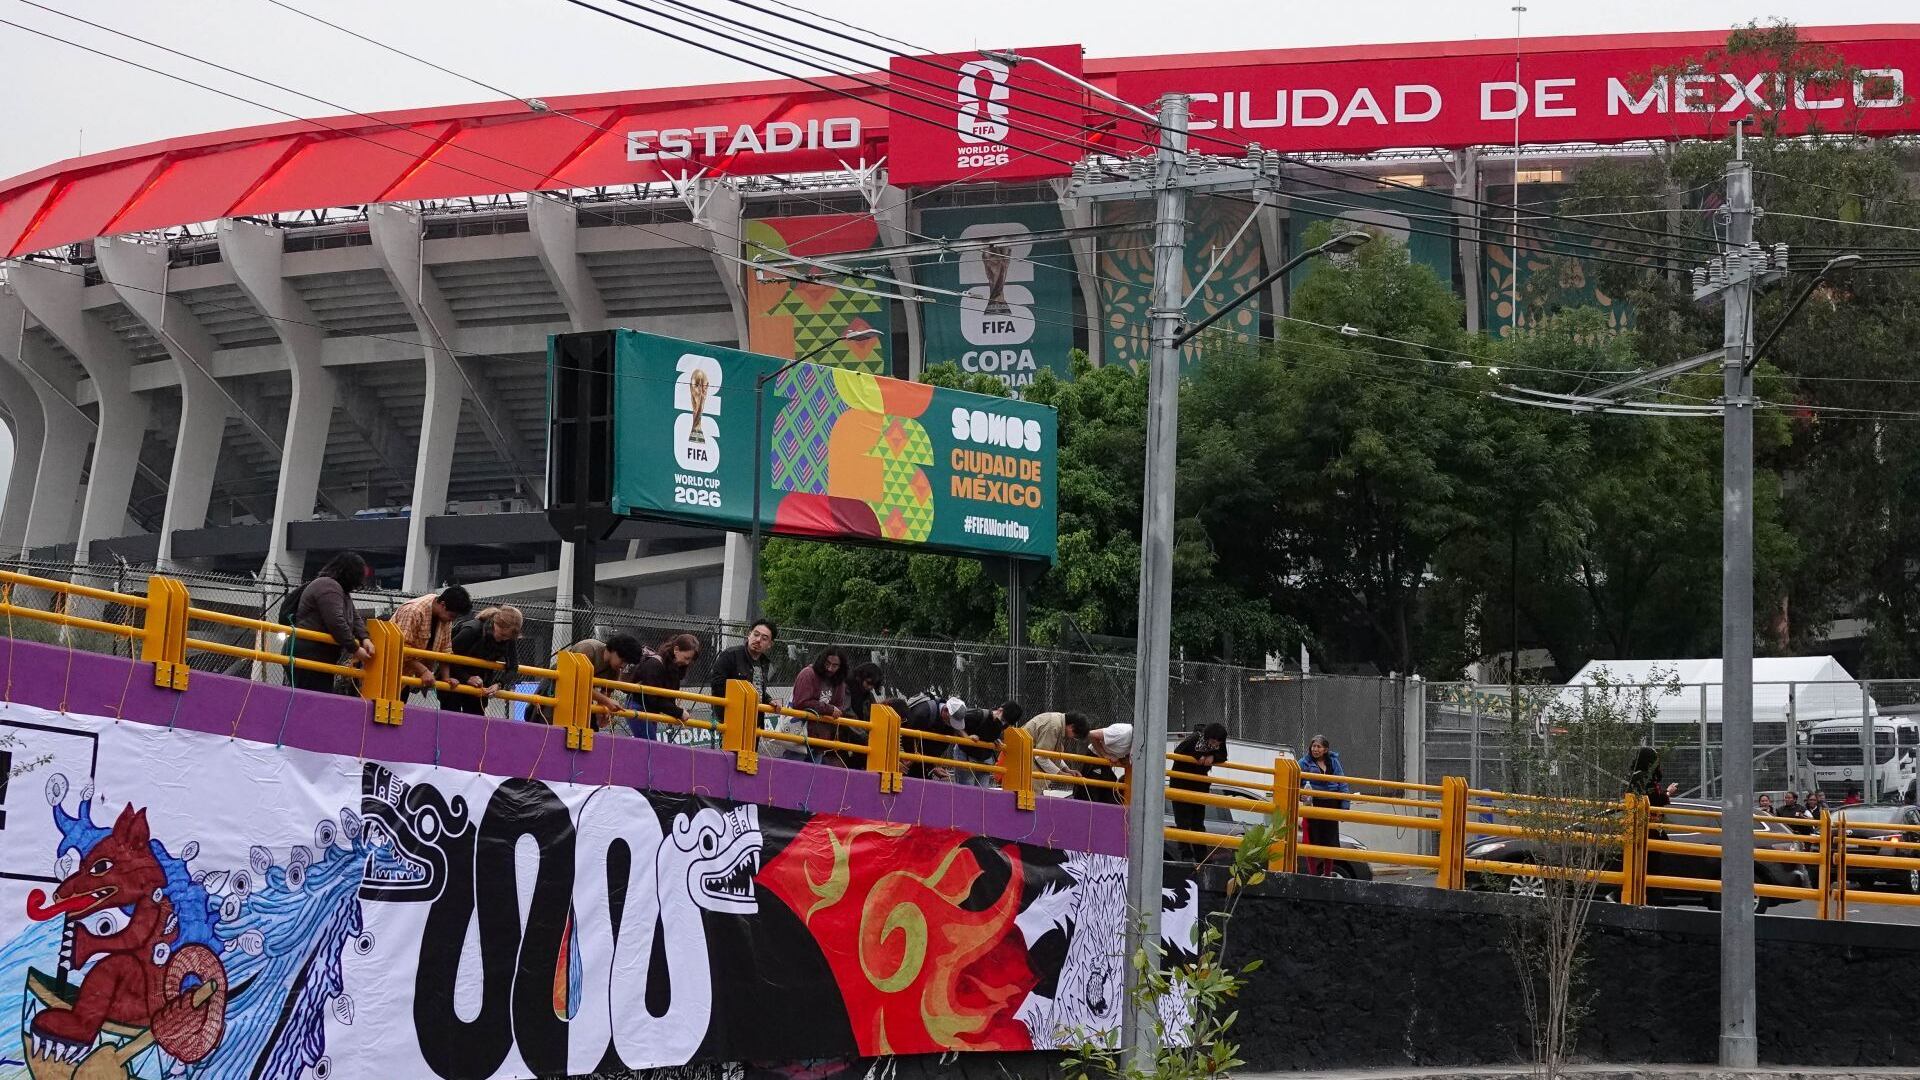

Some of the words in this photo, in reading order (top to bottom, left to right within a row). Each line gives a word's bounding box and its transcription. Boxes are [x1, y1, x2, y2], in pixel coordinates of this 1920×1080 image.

[1186, 84, 1442, 130] CIUDAD
[1480, 78, 1577, 121] DE
[627, 117, 861, 162] ESTADIO
[972, 125, 996, 135] FIFA
[957, 153, 1009, 169] 2026
[958, 145, 990, 155] WORLD
[990, 144, 1009, 153] CUP
[982, 320, 1016, 334] FIFA
[961, 349, 1037, 373] COPA
[951, 407, 1042, 452] SOMOS
[687, 447, 708, 462] FIFA
[951, 448, 1017, 478] CIUDAD
[1019, 458, 1041, 482] DE
[674, 473, 703, 487] WORLD
[704, 477, 721, 488] CUP
[951, 473, 1041, 509] MÉXICO
[674, 486, 722, 508] 2026
[964, 515, 1030, 543] #FIFAWorldCup
